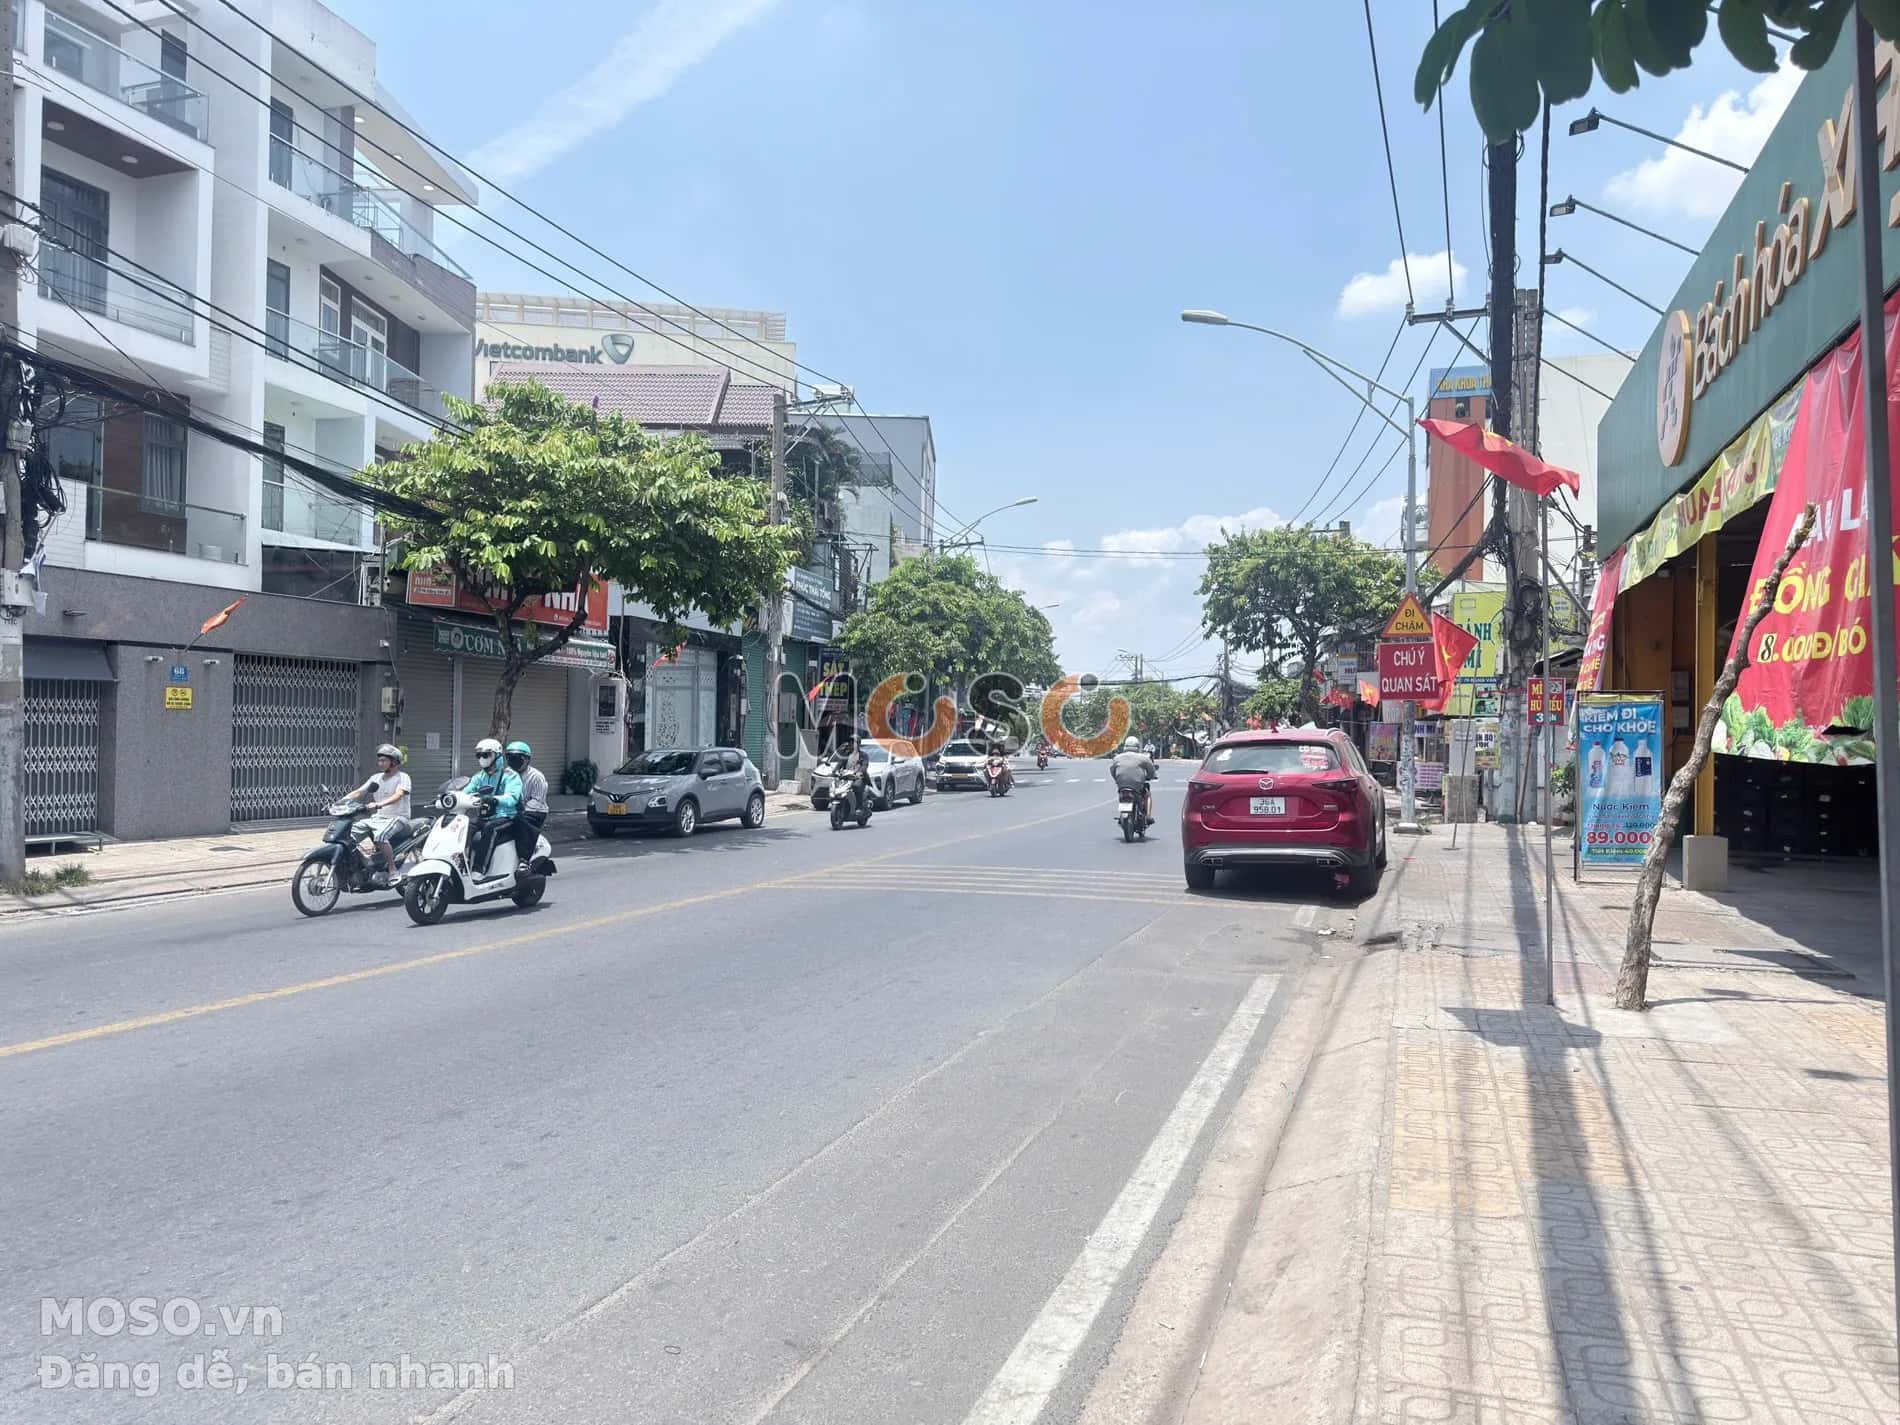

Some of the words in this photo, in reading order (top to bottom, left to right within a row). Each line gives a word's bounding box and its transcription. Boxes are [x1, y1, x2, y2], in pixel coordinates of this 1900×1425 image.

[1693, 280, 1749, 400] Bách
[1749, 561, 1831, 615] ĐỒNG
[1844, 552, 1872, 603] GI
[1405, 608, 1415, 618] ĐI
[1395, 620, 1424, 633] CHẬM
[1393, 646, 1416, 666] CHÚ
[1418, 646, 1425, 665] Ý
[1381, 677, 1412, 693] QUAN
[1415, 673, 1437, 692] SÁT
[1583, 723, 1613, 733] CHO
[1586, 830, 1652, 845] 89.000
